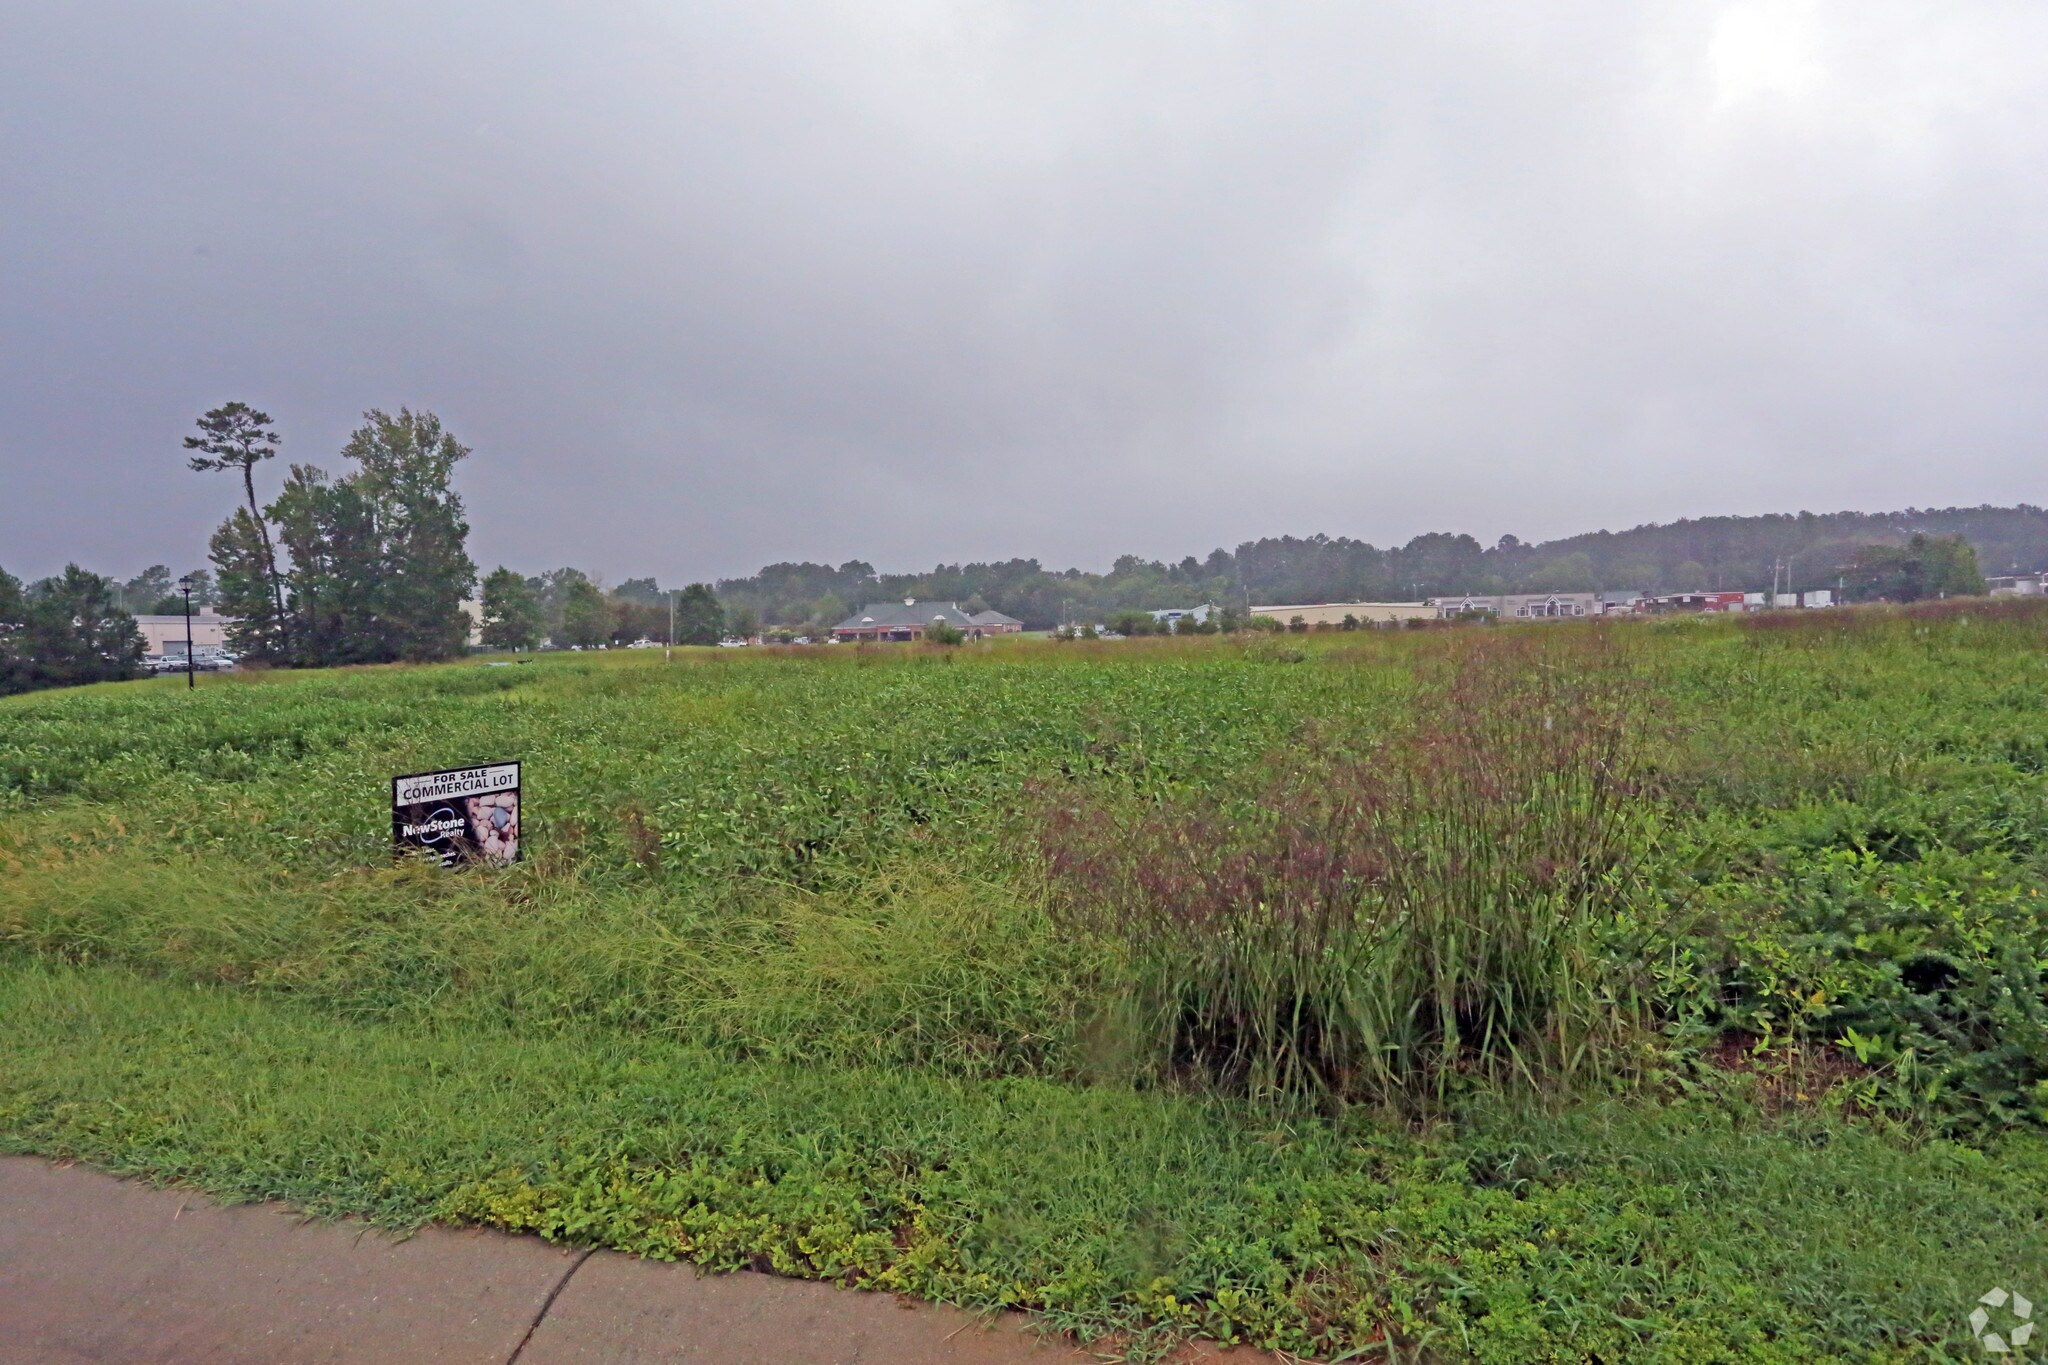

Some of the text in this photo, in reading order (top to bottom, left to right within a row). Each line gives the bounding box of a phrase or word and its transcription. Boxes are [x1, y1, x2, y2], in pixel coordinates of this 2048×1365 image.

[433, 769, 487, 784] FOR SALE
[403, 774, 513, 800] COMMERCIAL LOT
[440, 828, 465, 839] Realty
